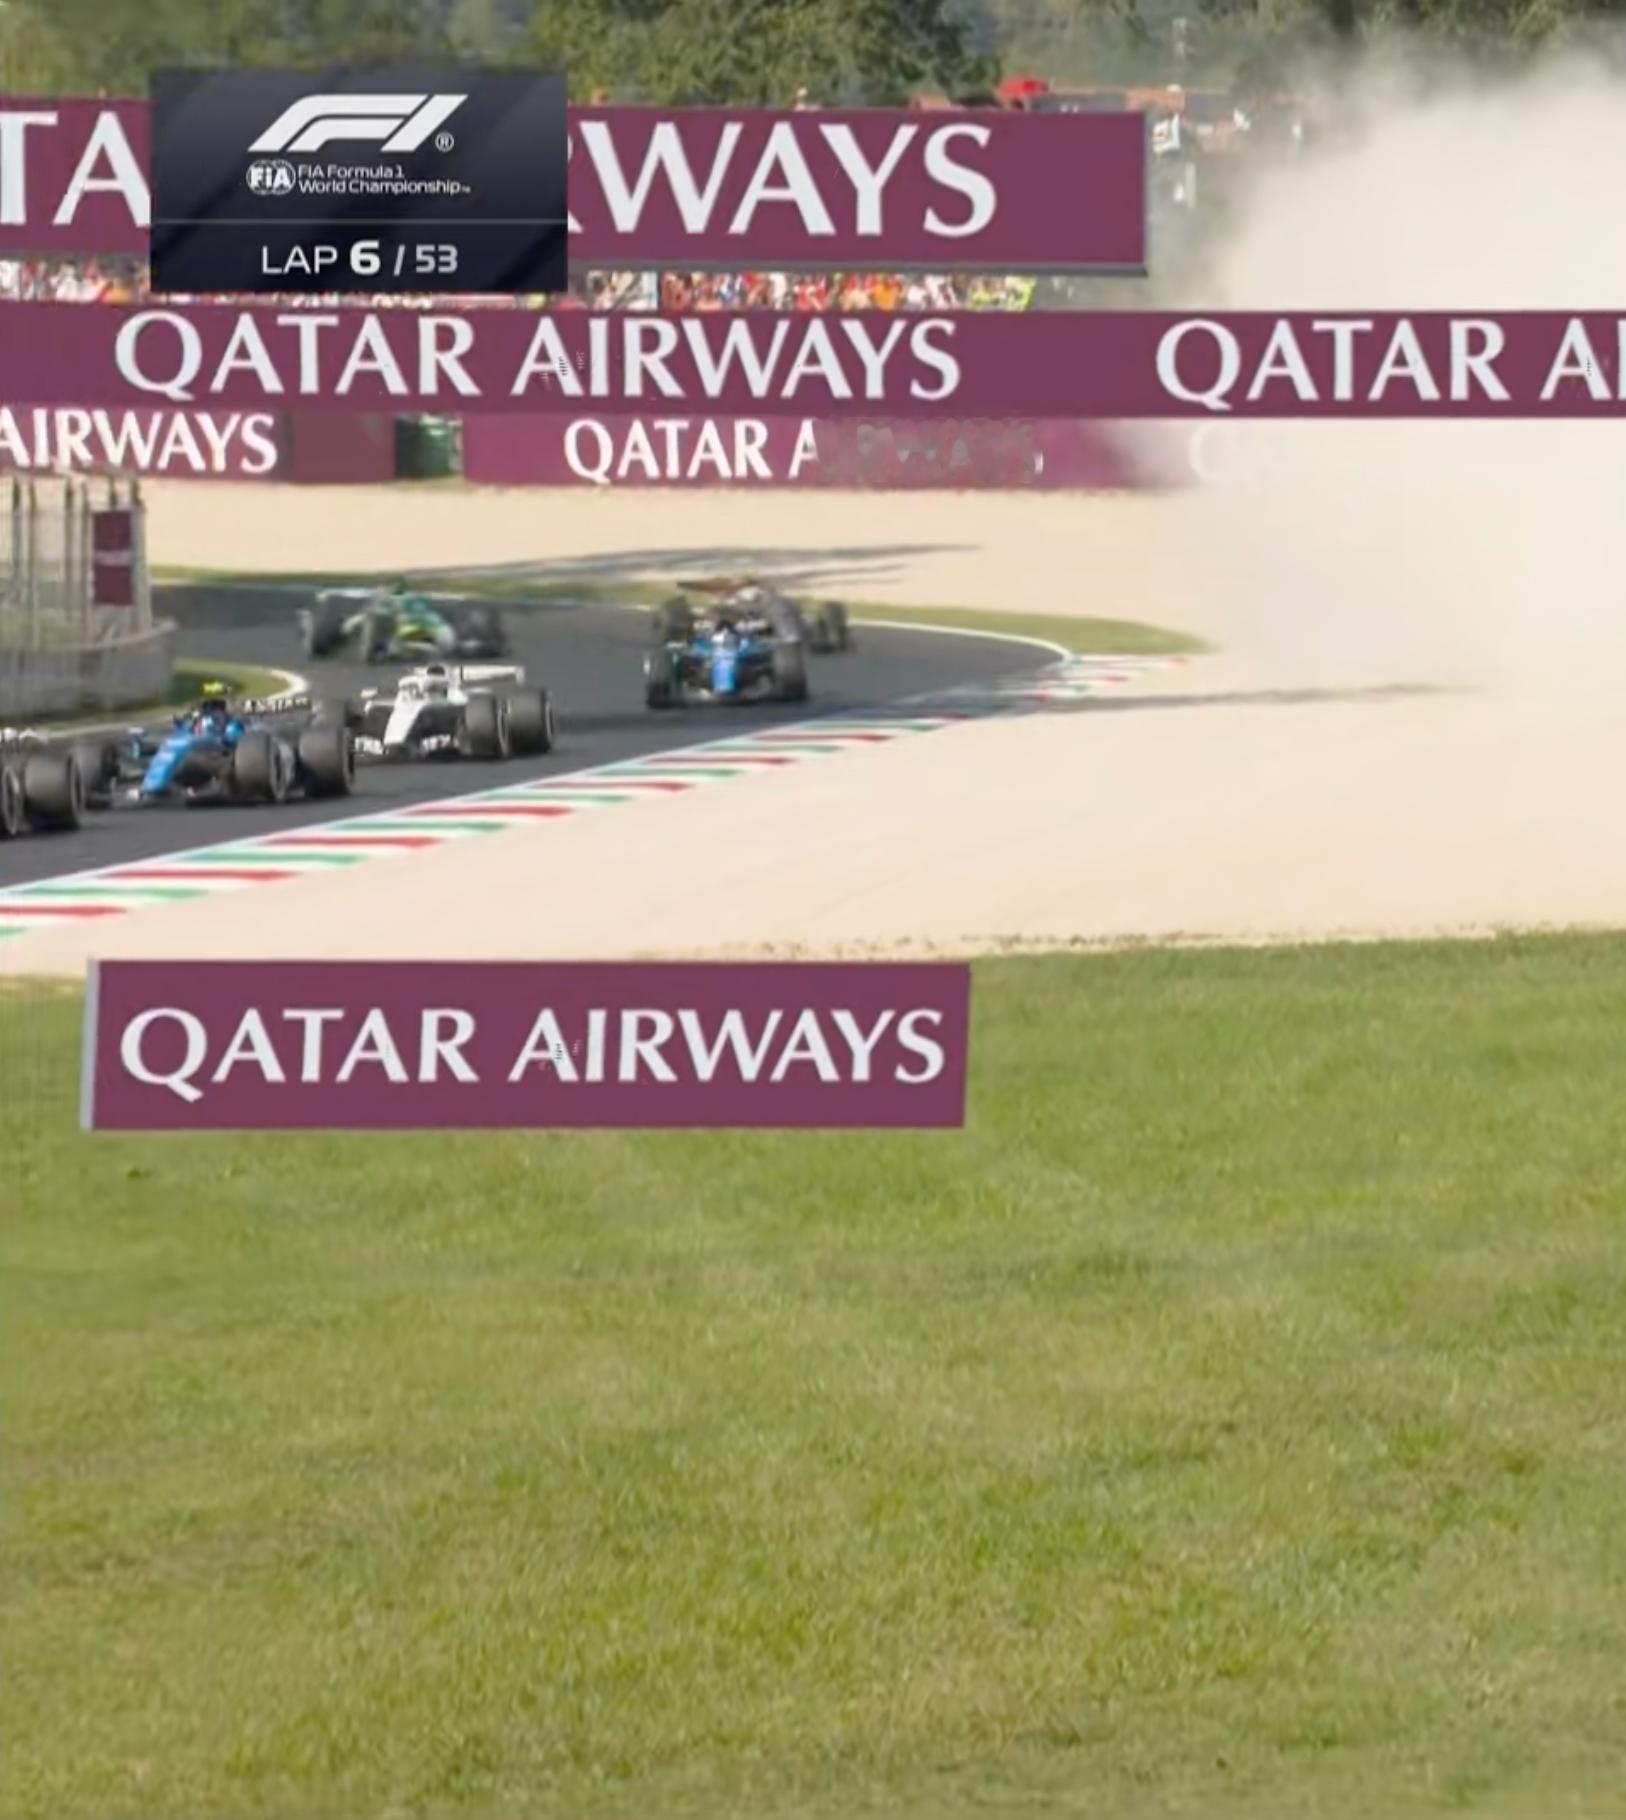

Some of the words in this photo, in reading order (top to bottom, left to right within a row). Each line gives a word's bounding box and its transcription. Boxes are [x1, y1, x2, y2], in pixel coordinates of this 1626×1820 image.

[568, 118, 998, 238] WAYS
[114, 310, 482, 400] QATAR
[510, 316, 962, 400] AIRWAYS
[1155, 318, 1511, 411] QATAR
[563, 418, 774, 485] QATAR
[118, 1007, 479, 1102] QATAR
[507, 1007, 945, 1084] AIRWAYS
